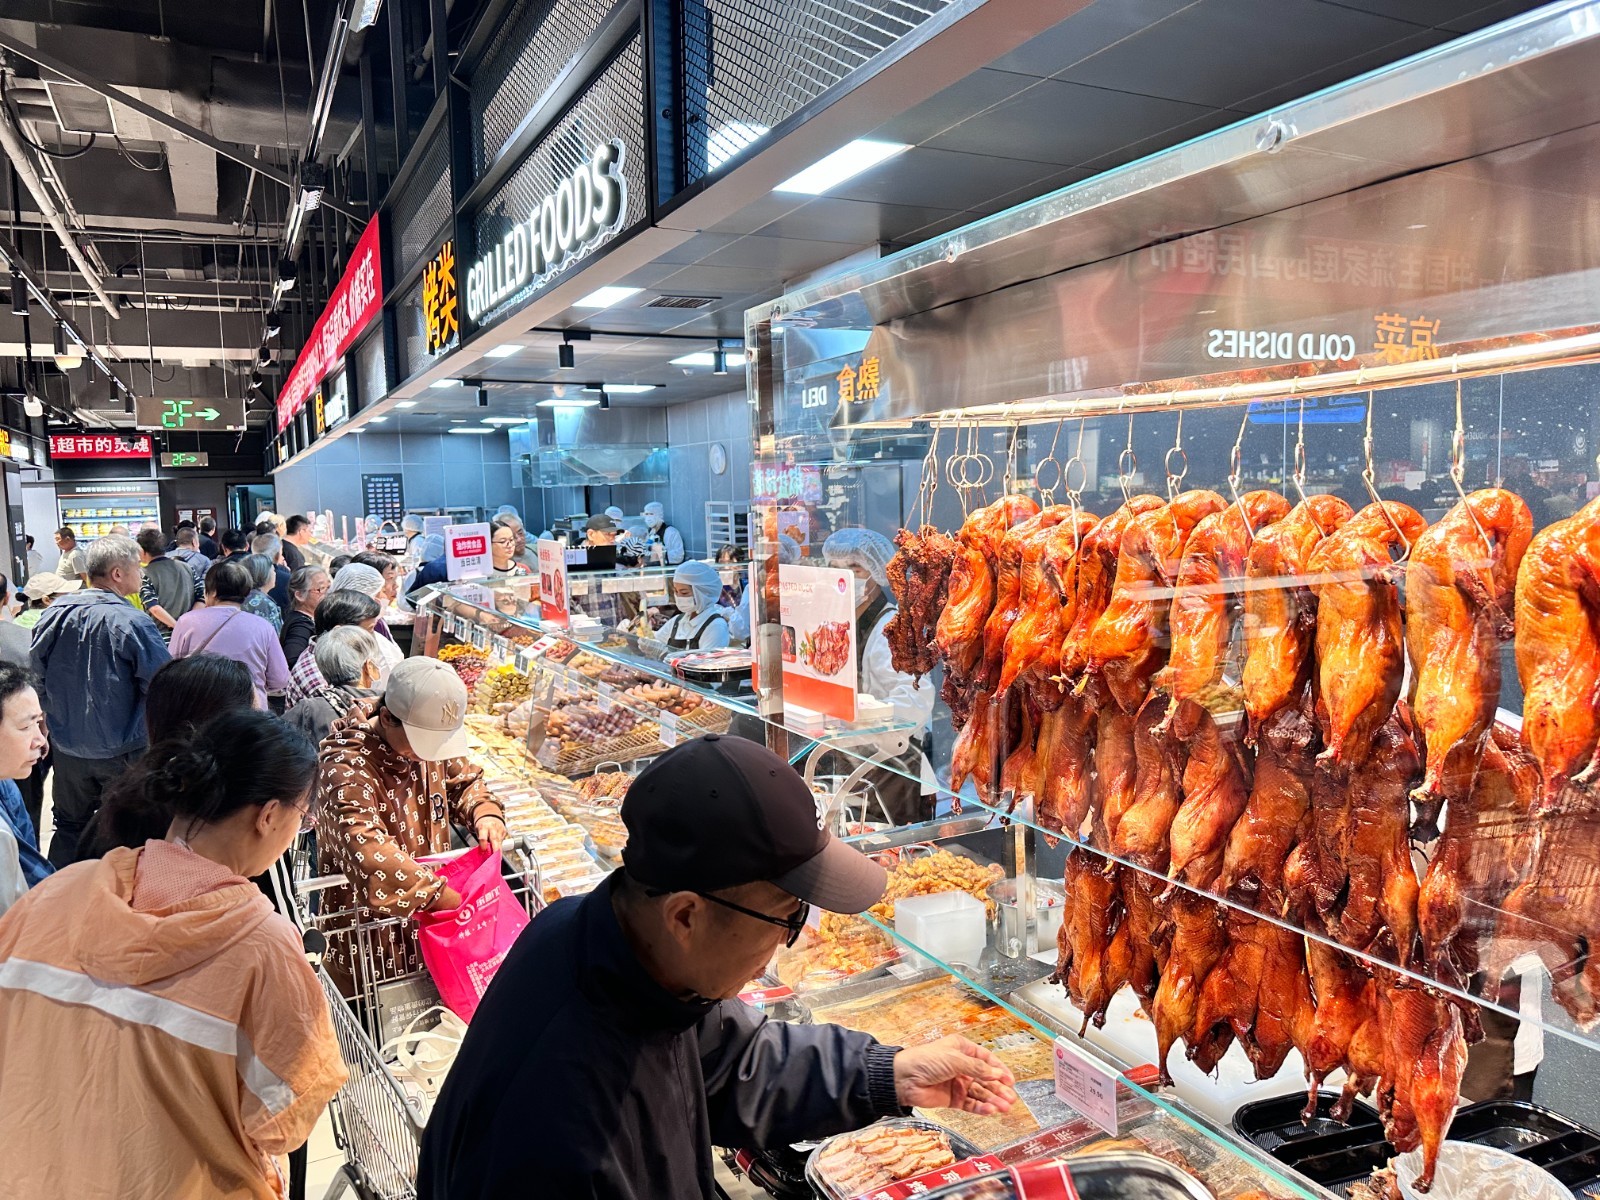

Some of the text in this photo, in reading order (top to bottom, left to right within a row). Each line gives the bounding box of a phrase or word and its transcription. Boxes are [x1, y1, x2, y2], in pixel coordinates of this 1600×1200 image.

[466, 143, 614, 322] GRILLED FOODS
[422, 239, 459, 356] 烤类
[162, 399, 194, 428] 2F
[172, 453, 186, 466] 2F
